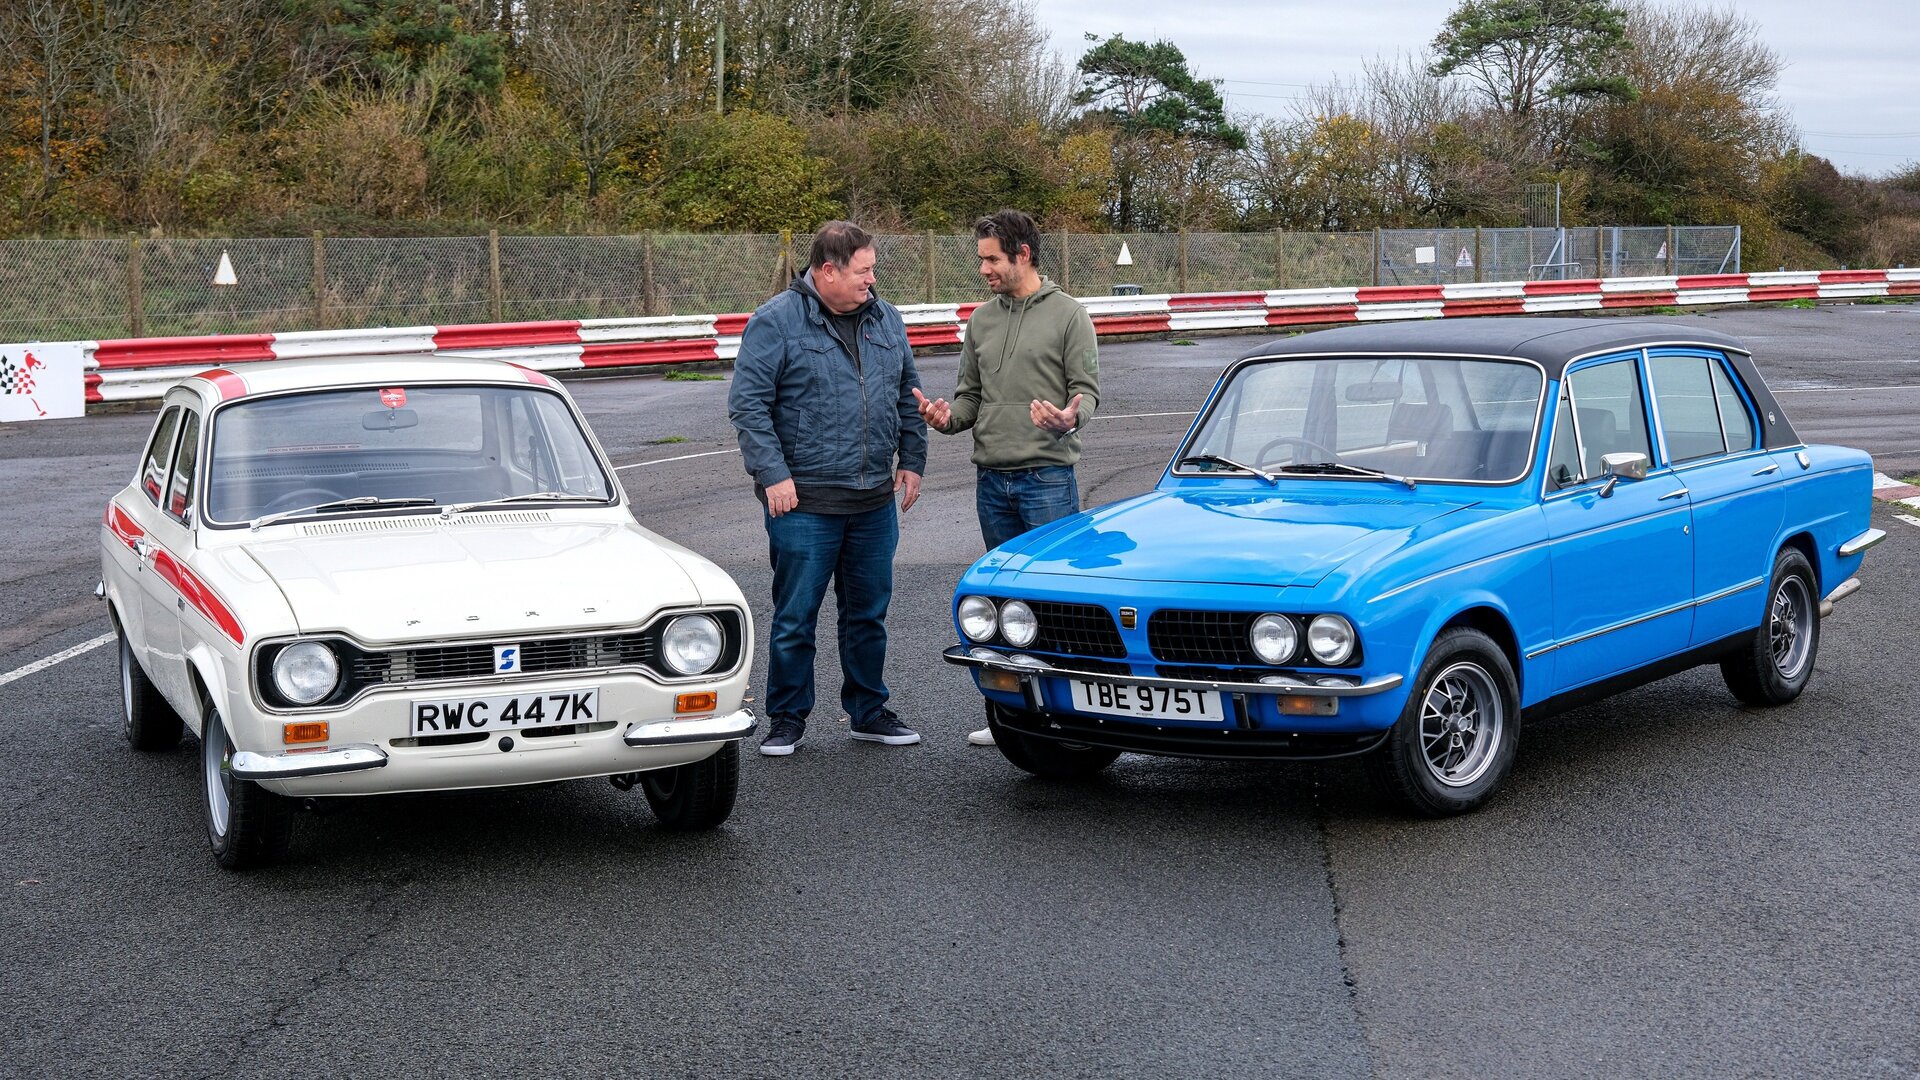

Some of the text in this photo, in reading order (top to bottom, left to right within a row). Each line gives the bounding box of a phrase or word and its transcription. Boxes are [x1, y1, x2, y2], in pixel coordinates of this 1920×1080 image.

[417, 691, 593, 732] RWC 447K
[1080, 681, 1208, 715] TBE 975T
